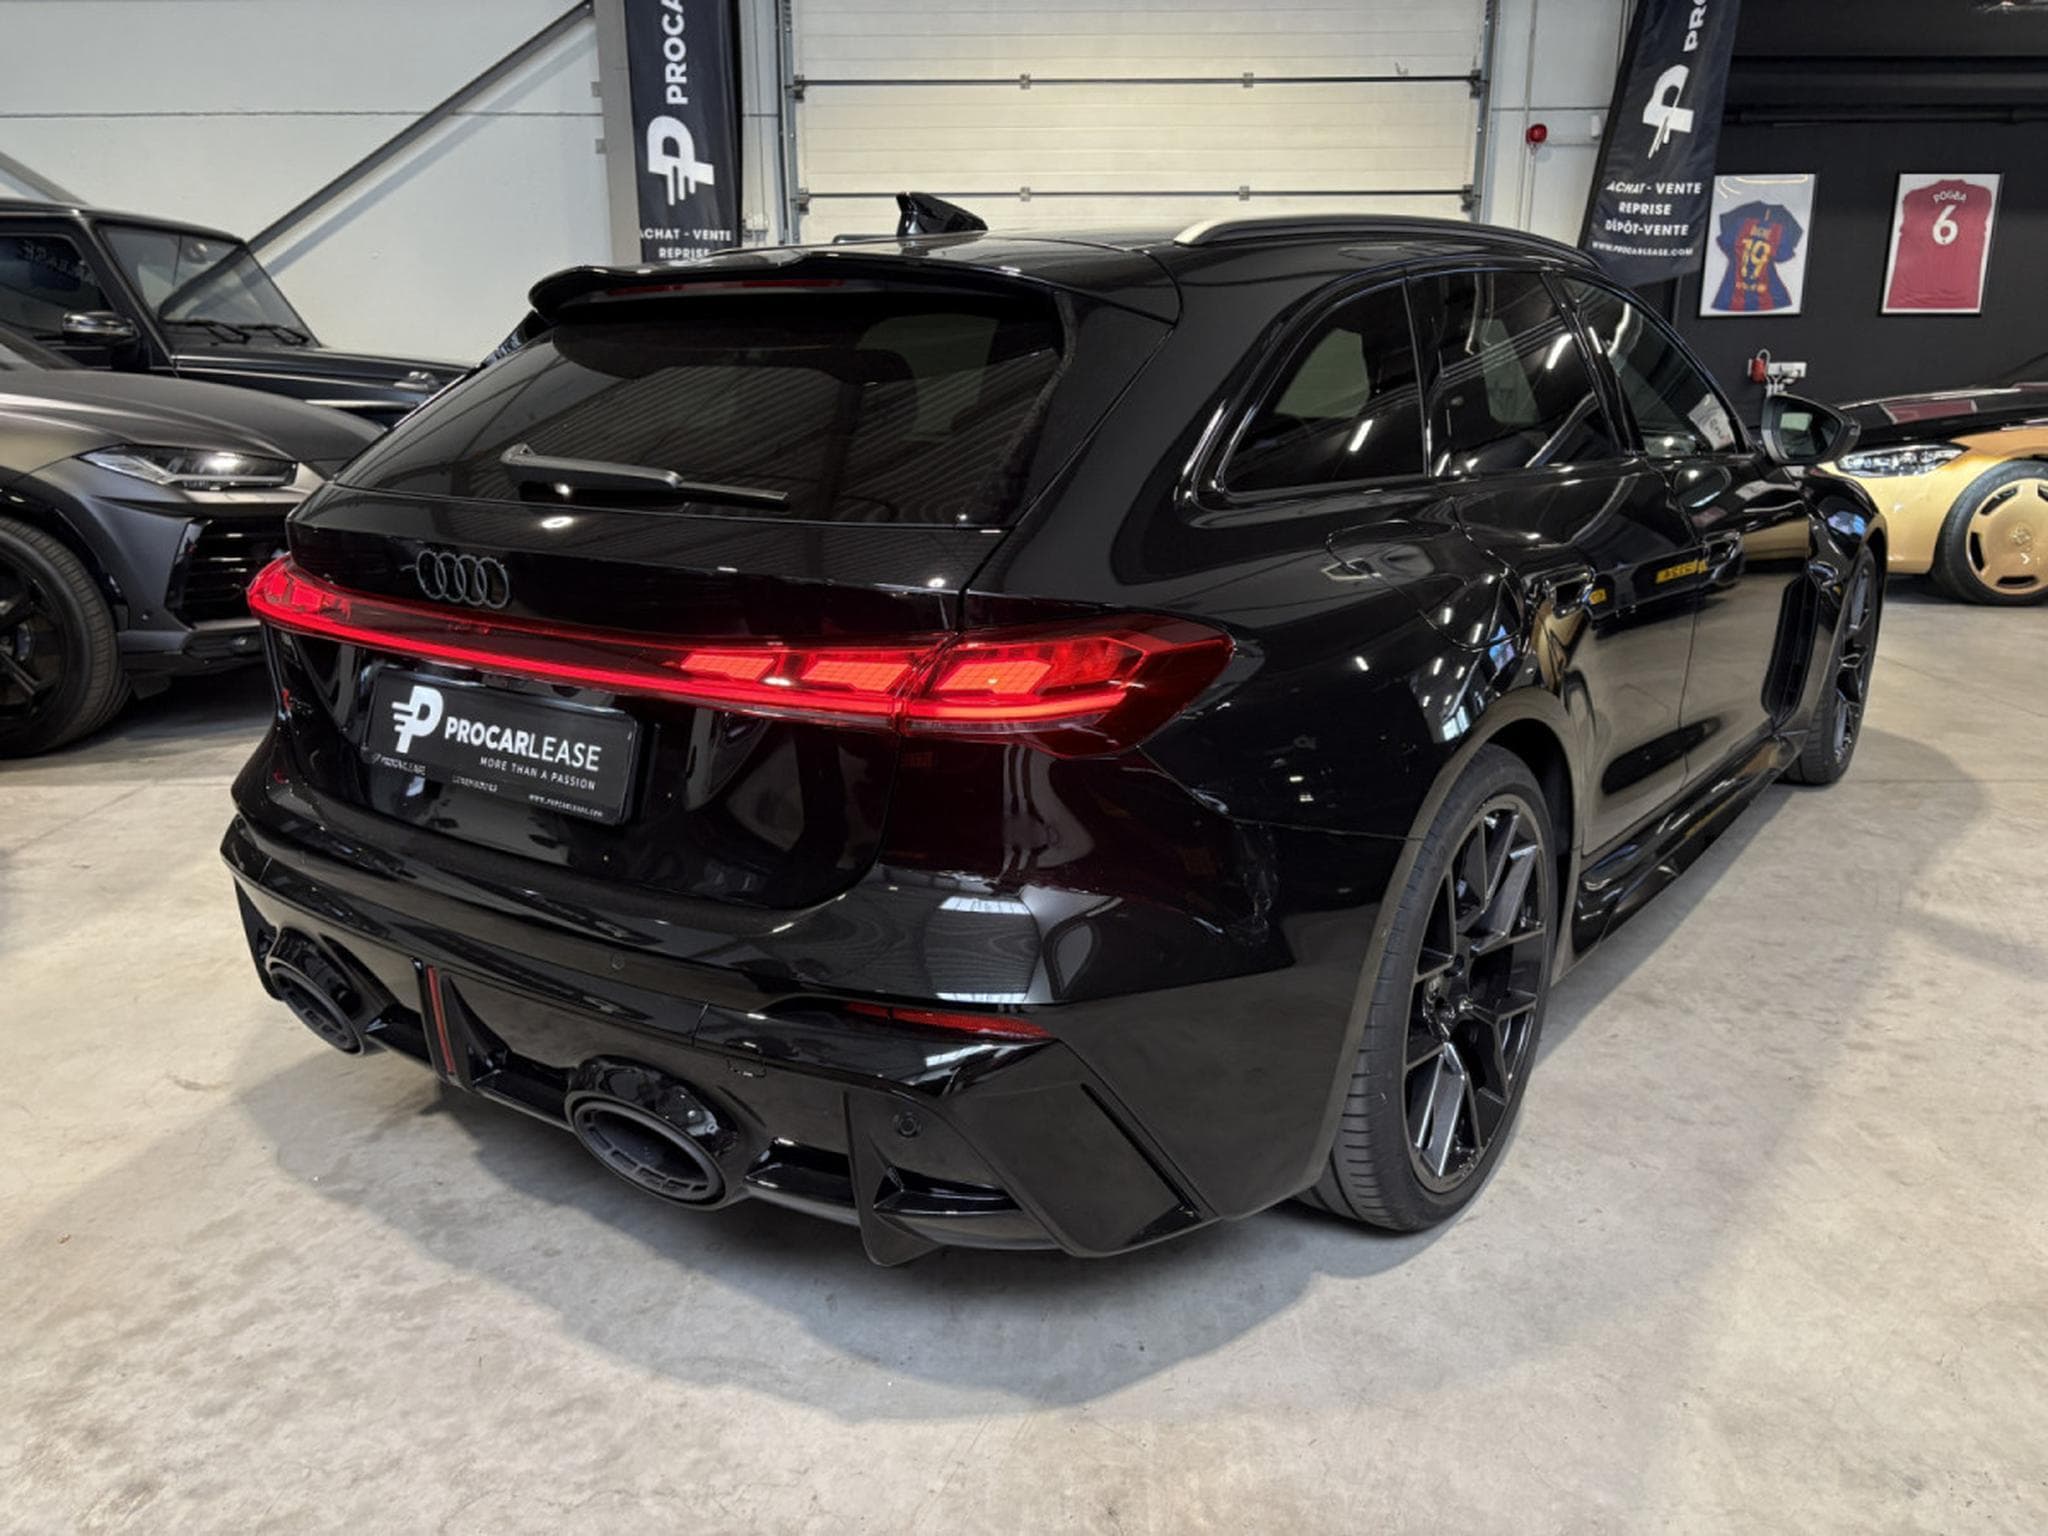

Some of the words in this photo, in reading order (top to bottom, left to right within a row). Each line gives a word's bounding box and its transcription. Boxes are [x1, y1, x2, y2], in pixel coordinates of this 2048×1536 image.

[1683, 0, 1707, 52] PR
[1606, 181, 1646, 194] ACHAT
[1655, 182, 1702, 195] VENTE
[1618, 201, 1672, 216] REPRISE
[1932, 204, 1958, 246] 6
[692, 229, 732, 241] VENTE
[1742, 239, 1771, 278] 19
[445, 717, 602, 771] PROCARLEASE
[480, 756, 507, 772] MORE
[511, 762, 538, 779] THAN
[540, 769, 548, 781] A
[550, 771, 596, 791] PASSION
